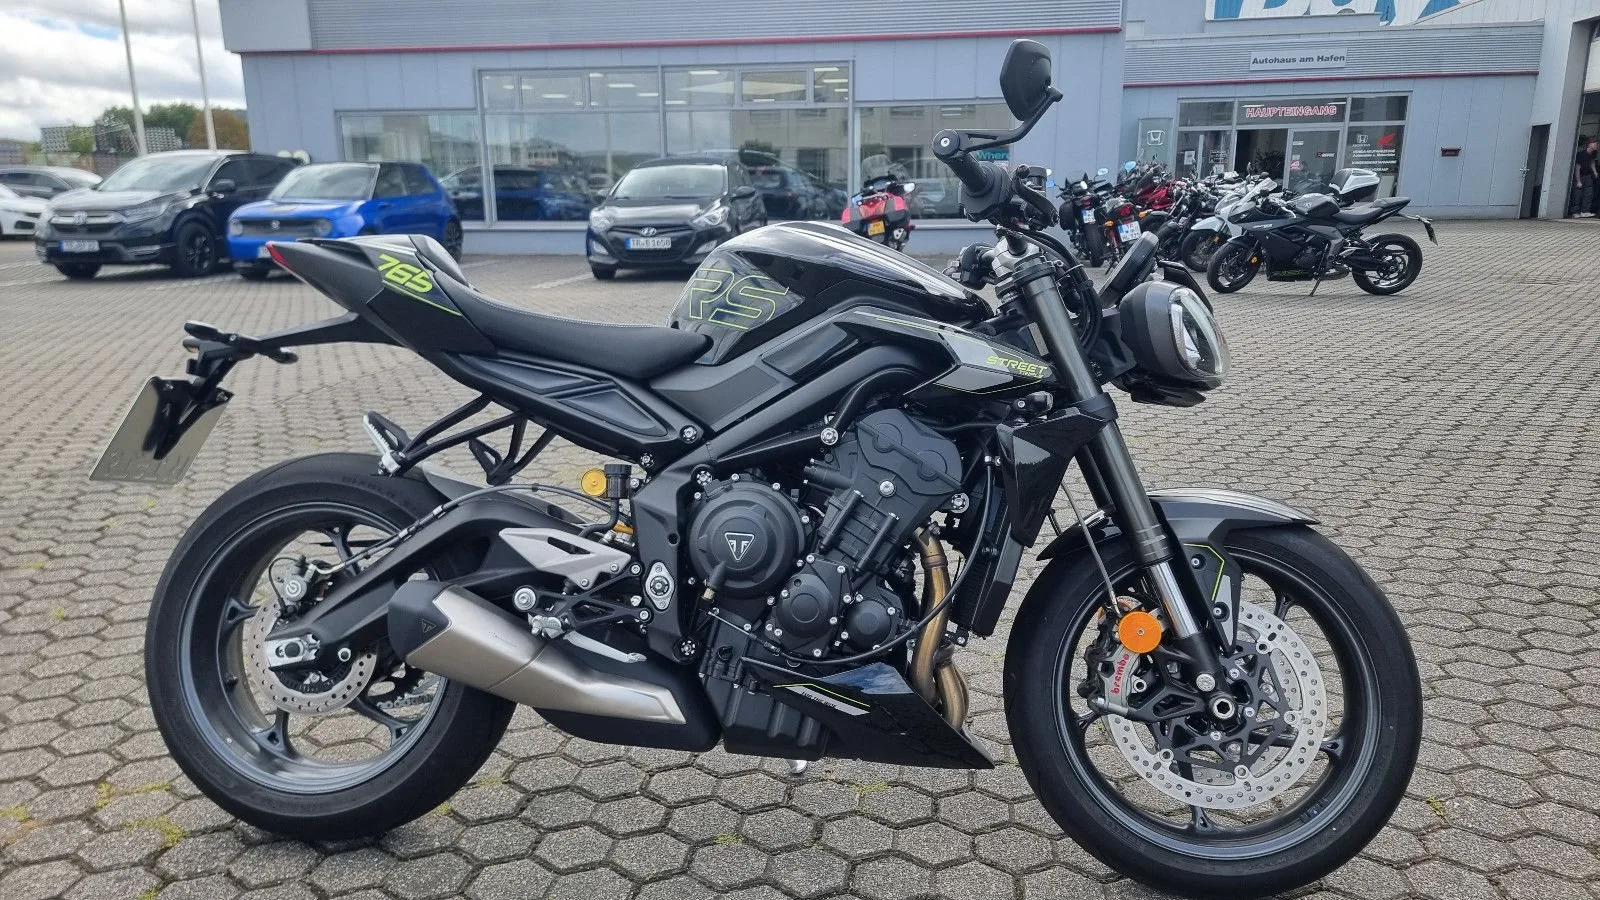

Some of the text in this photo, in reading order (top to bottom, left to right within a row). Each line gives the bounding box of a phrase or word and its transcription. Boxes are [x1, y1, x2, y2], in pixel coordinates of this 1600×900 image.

[1252, 57, 1297, 65] Autohaus
[1317, 54, 1345, 62] Hafen
[1246, 105, 1337, 117] HAUPTEINGANG
[378, 253, 433, 293] 765
[986, 355, 1048, 374] STREET
[1110, 653, 1130, 694] brembo
